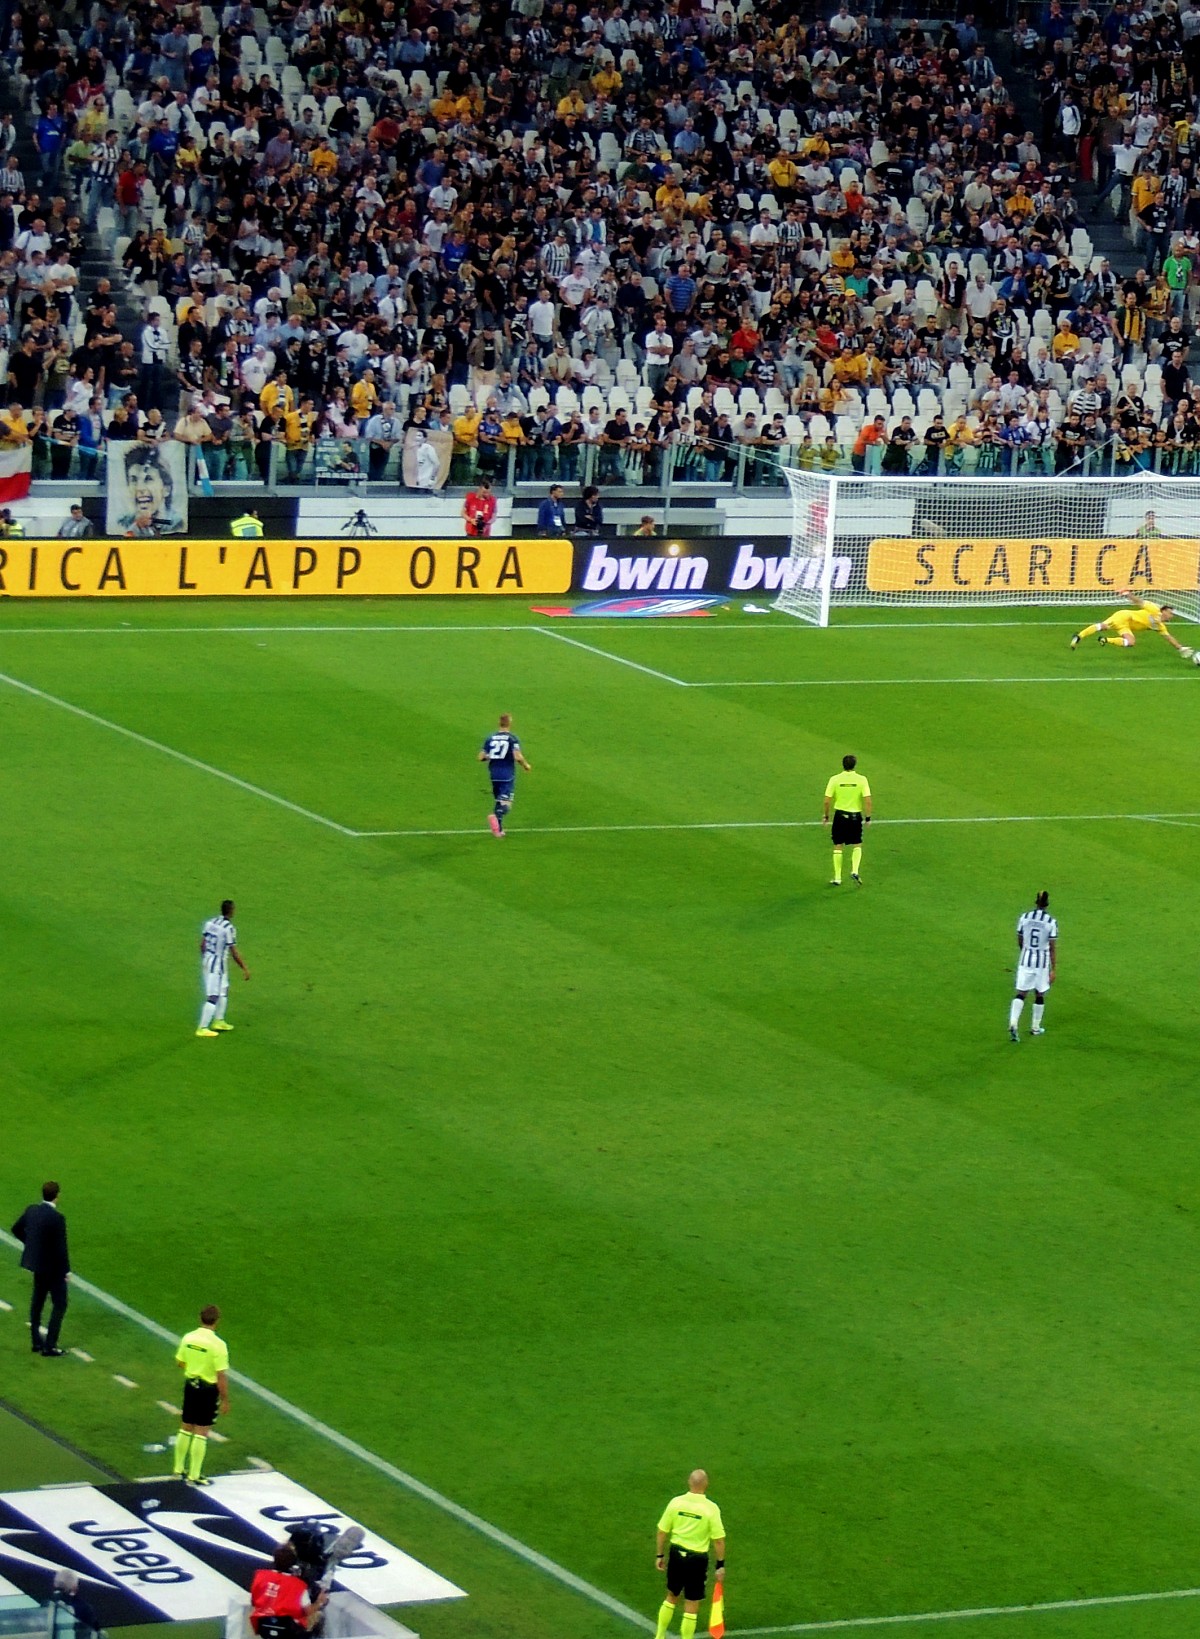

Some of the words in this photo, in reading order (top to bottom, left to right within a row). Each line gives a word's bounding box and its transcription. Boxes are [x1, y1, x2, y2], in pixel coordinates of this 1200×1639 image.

[178, 546, 362, 590] L'APP
[410, 546, 523, 590] ORA
[583, 544, 709, 591] bwin
[729, 544, 851, 590] bwin
[914, 544, 1153, 586] SCARICA
[489, 740, 510, 760] 27
[1030, 928, 1041, 948] 6
[68, 1519, 195, 1584] Jeep
